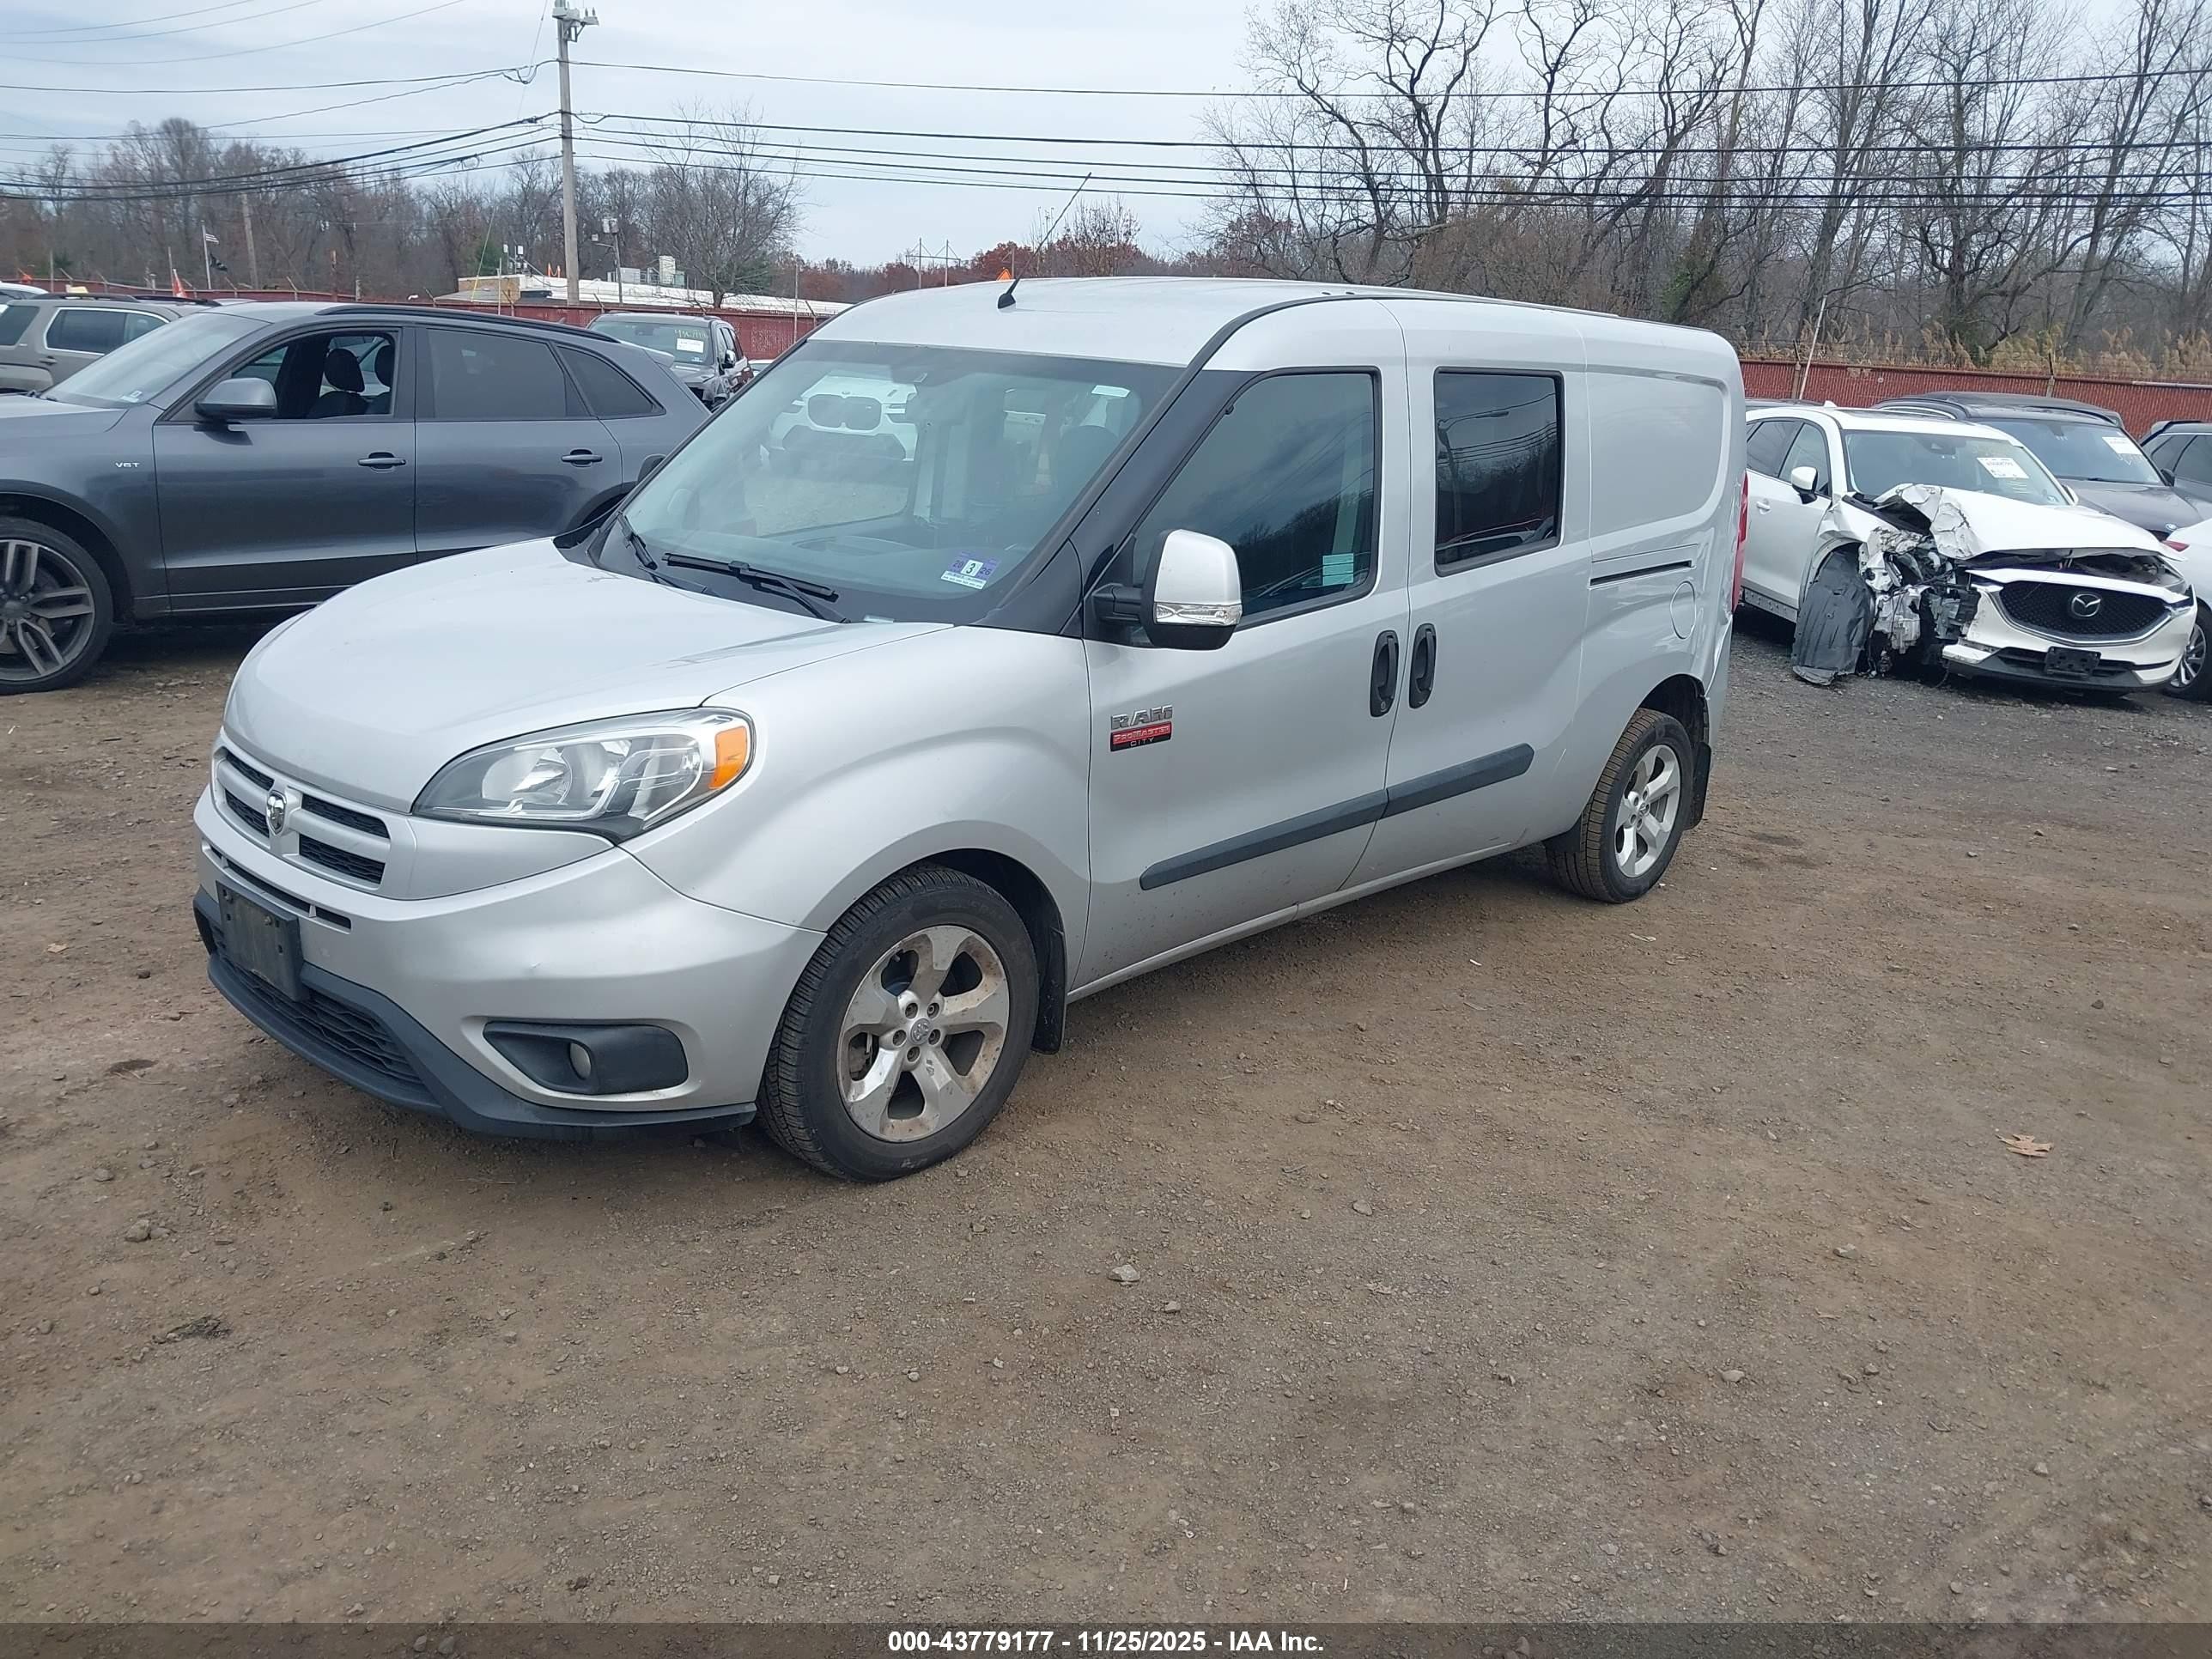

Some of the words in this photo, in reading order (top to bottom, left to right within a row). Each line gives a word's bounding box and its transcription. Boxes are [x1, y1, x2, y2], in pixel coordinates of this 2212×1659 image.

[966, 562, 976, 574] 3
[980, 567, 992, 576] 26
[1110, 704, 1173, 730] RAM
[1130, 737, 1155, 747] CITY
